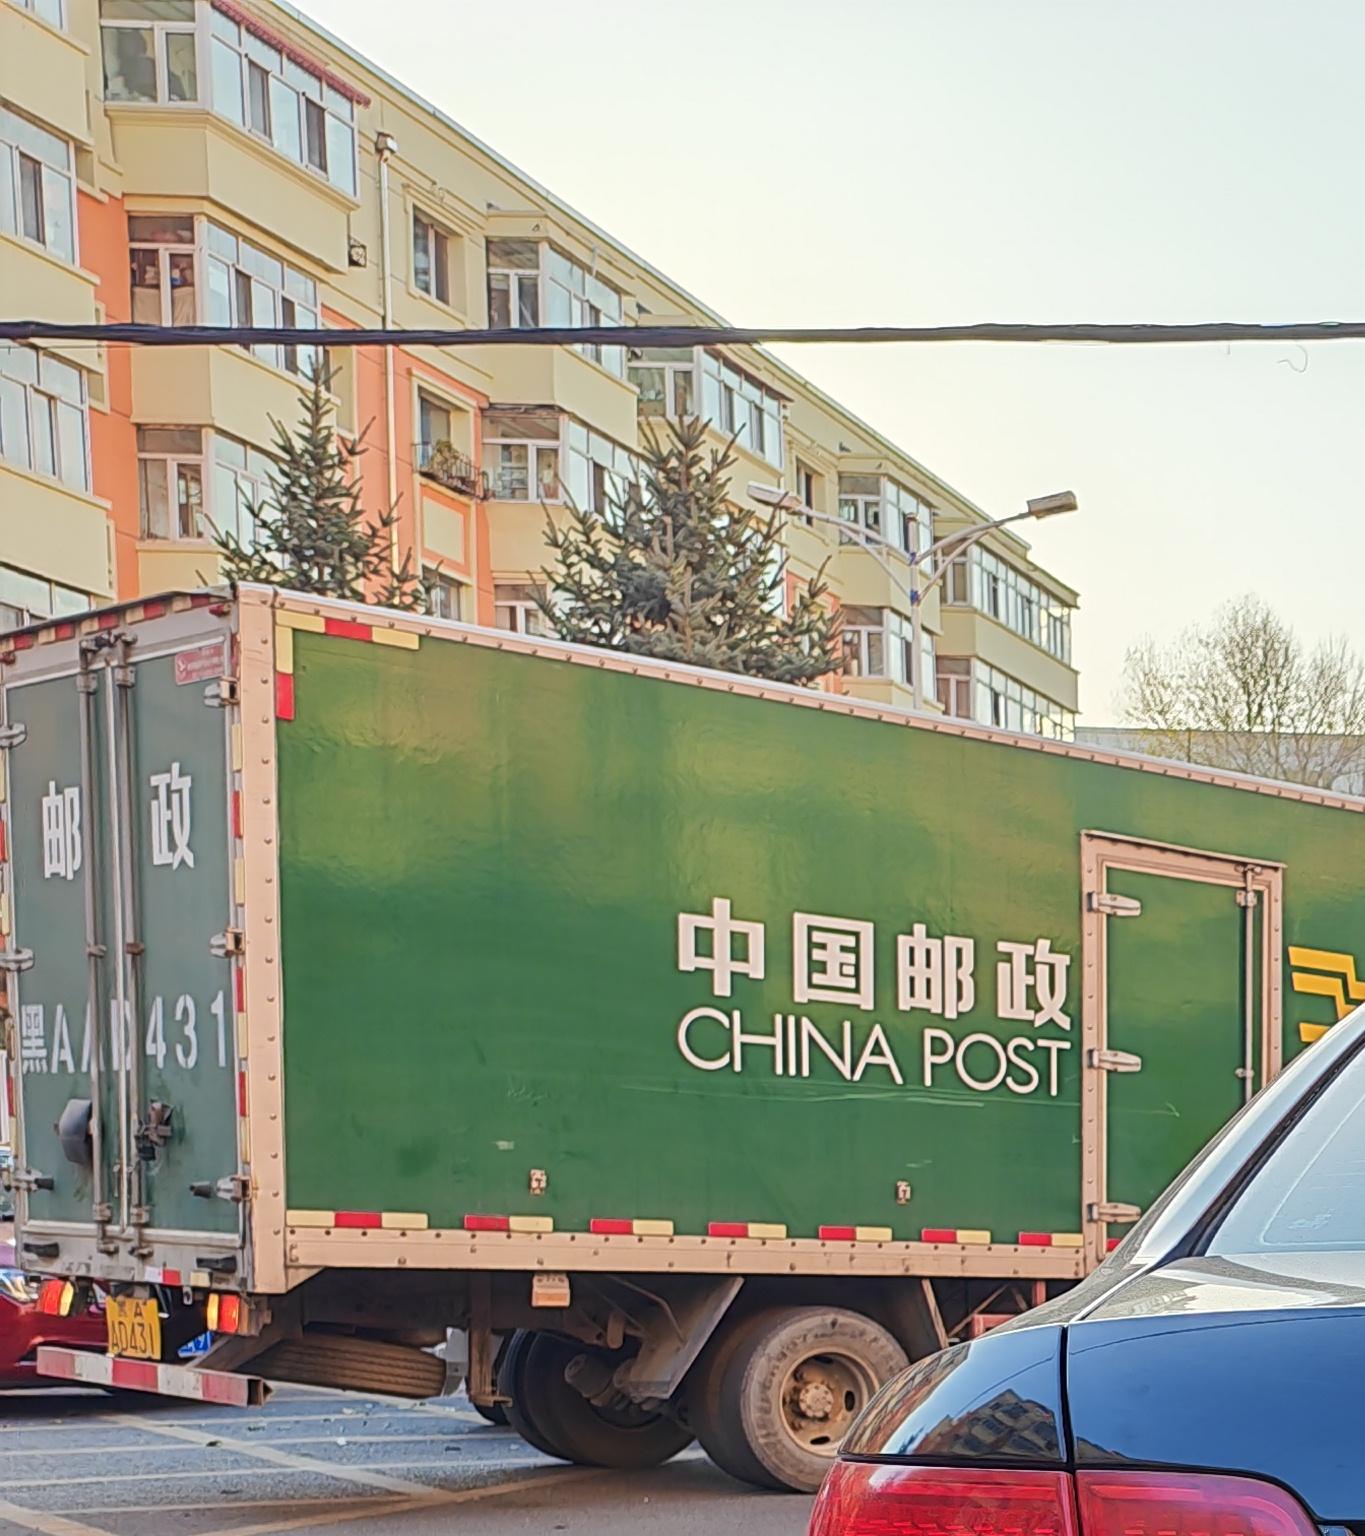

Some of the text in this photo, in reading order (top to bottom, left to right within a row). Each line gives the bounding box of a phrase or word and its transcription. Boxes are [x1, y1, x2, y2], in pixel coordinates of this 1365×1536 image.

[42, 762, 194, 881] 邮政
[677, 897, 1071, 1031] 中国邮政
[677, 1007, 1071, 1096] CHINA POST
[111, 1320, 155, 1356] AD431
